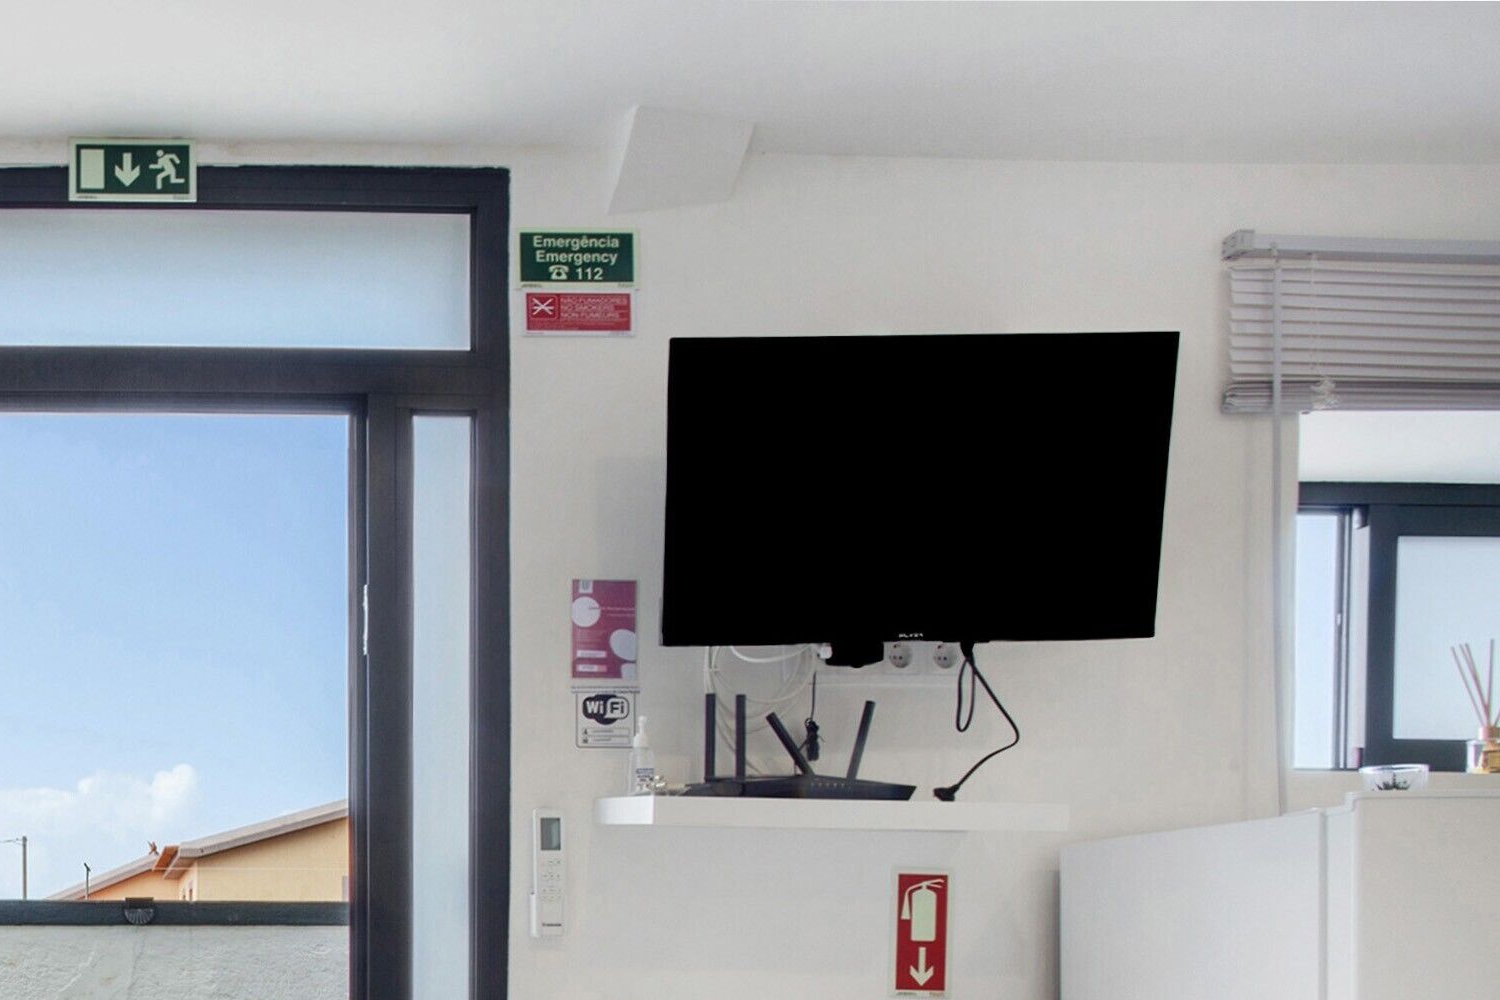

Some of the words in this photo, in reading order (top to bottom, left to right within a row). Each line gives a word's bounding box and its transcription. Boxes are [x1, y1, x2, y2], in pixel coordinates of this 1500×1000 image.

[533, 235, 620, 250] Emergência
[535, 250, 618, 265] Emergency
[576, 267, 604, 281] 112
